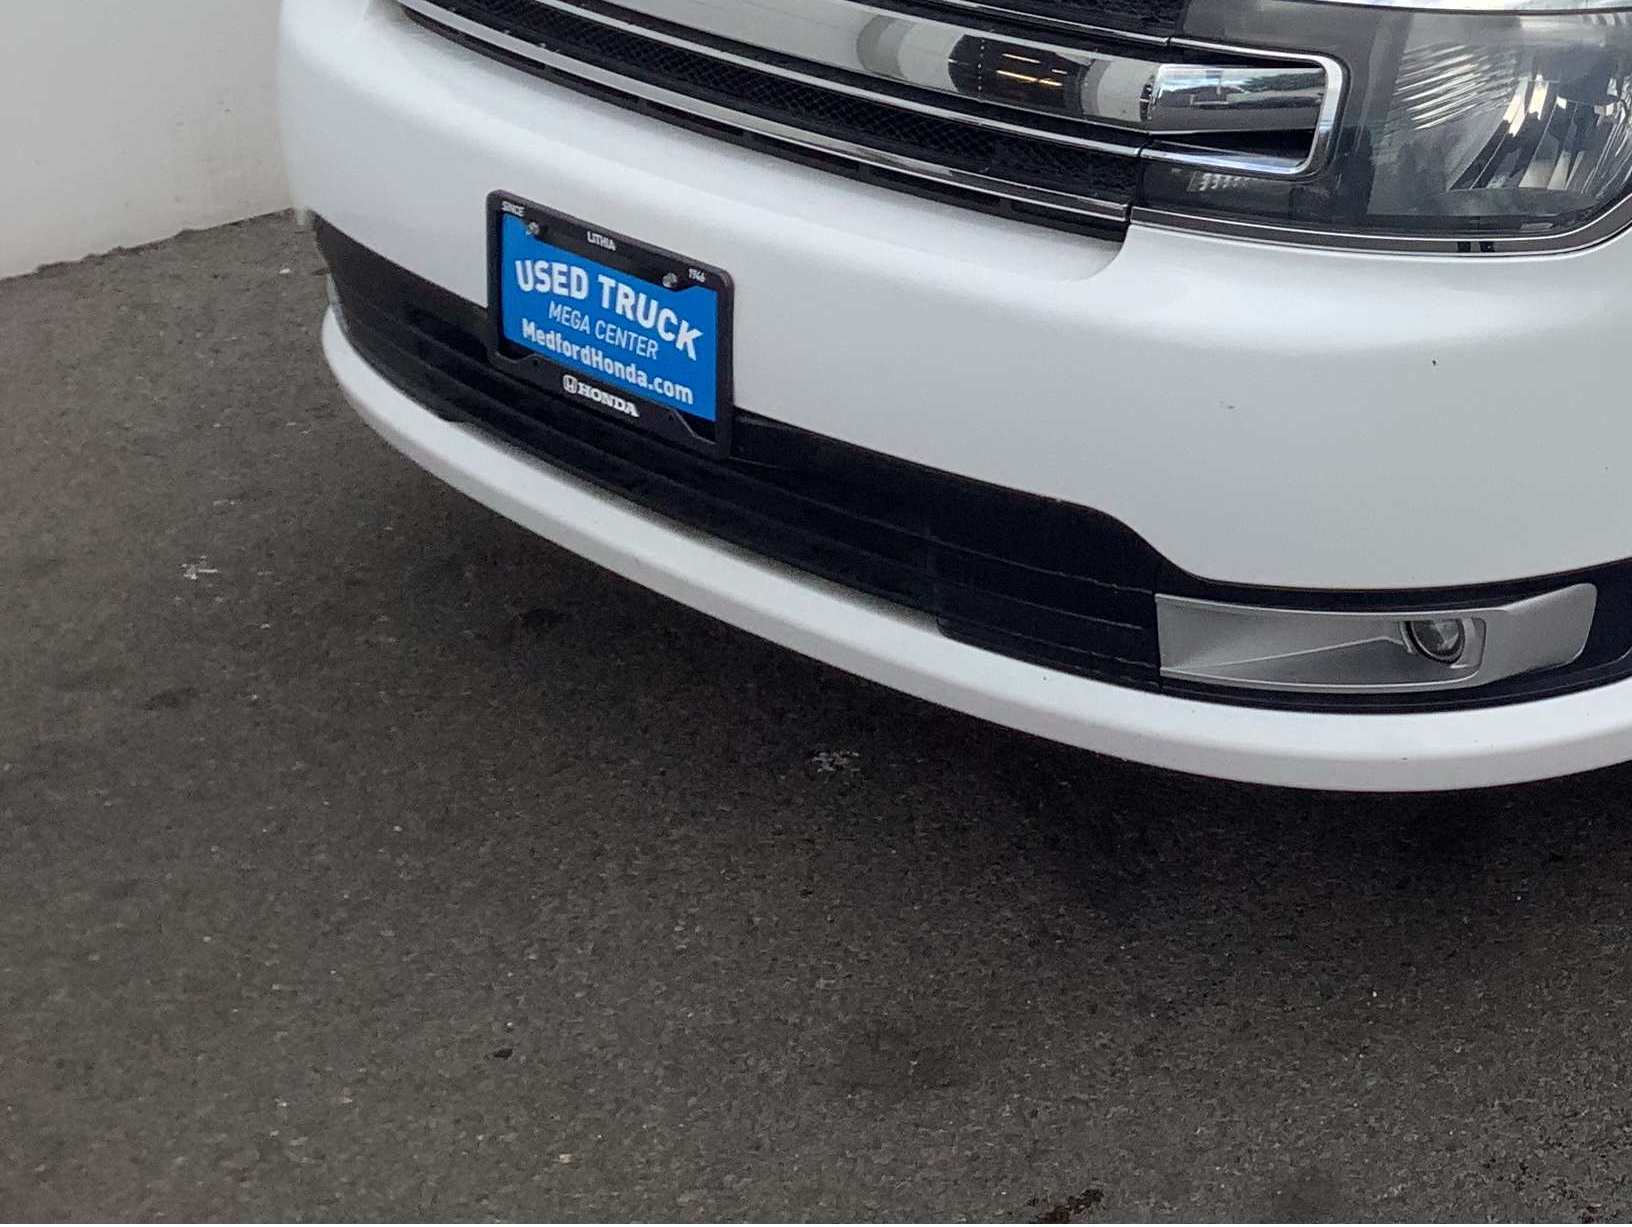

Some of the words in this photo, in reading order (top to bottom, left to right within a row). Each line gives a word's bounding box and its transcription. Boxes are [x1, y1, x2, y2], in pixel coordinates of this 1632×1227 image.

[586, 231, 616, 252] LITHIA
[515, 259, 589, 301] USED
[598, 274, 704, 361] TRUCK
[548, 300, 590, 335] MEGA
[595, 319, 659, 360] CENTER
[522, 318, 694, 405] MedfordHonda.com
[577, 383, 640, 418] HONDA
